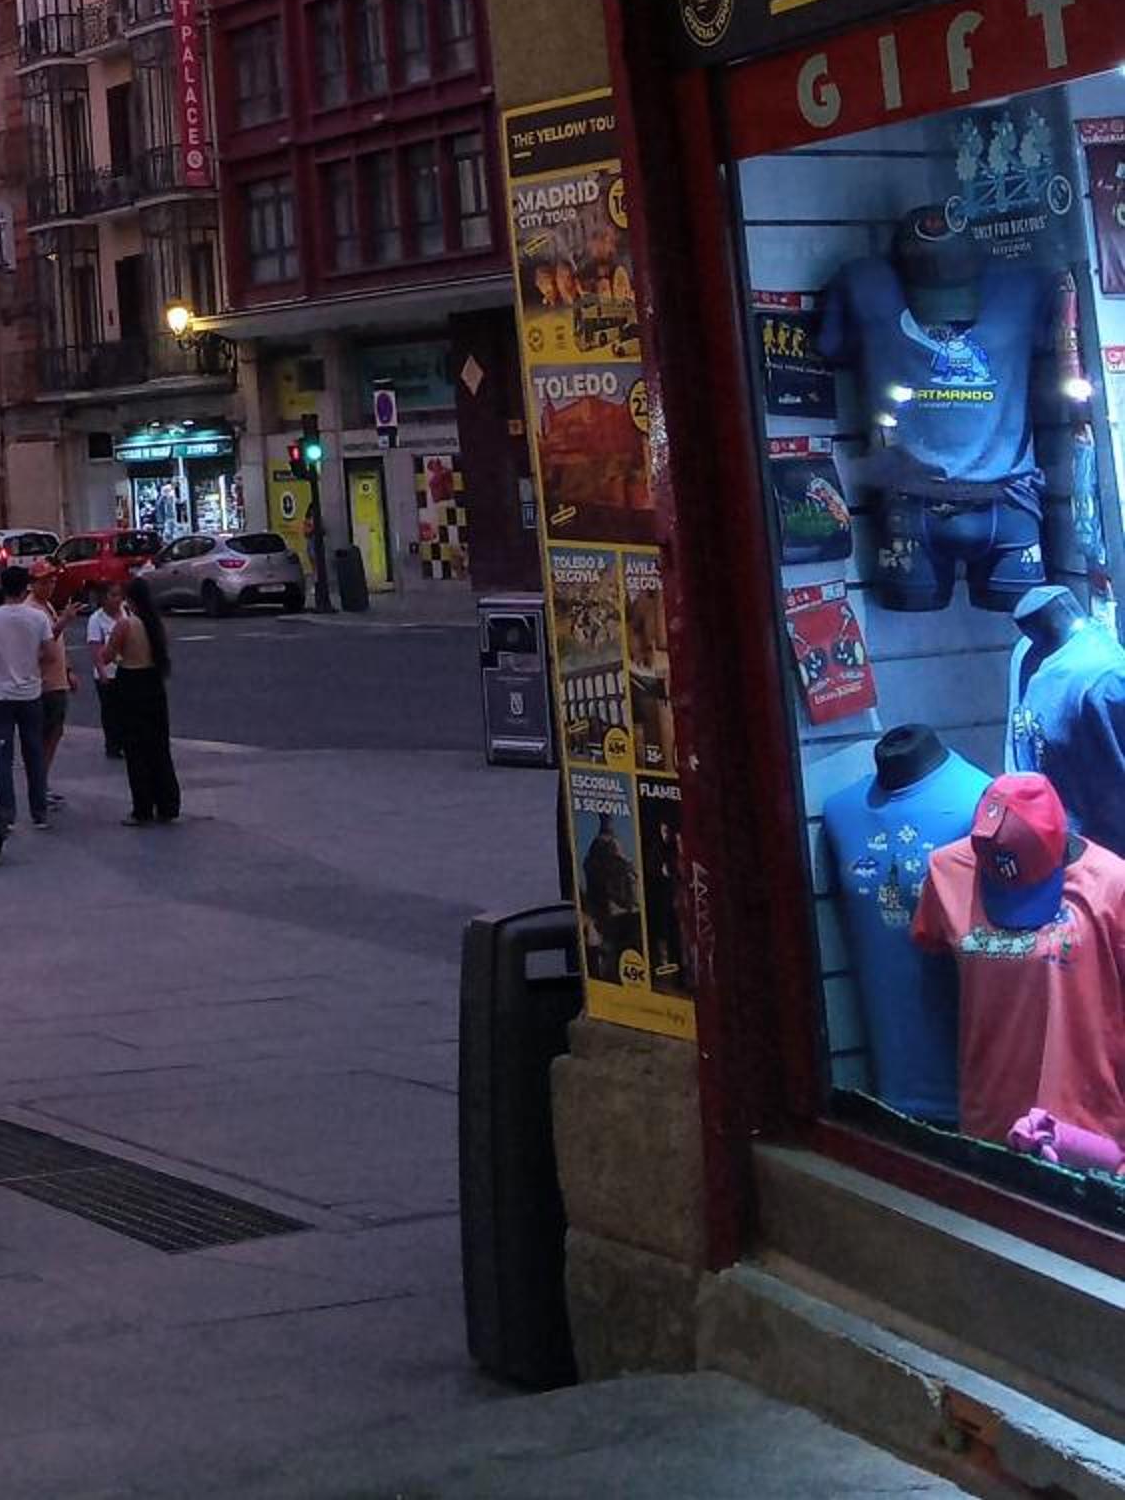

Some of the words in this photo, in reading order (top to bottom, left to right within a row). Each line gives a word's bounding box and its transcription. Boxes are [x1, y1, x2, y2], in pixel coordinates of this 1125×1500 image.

[182, 26, 200, 145] PALACE
[512, 130, 536, 149] THE
[536, 120, 586, 145] YELLOW
[516, 180, 600, 212] MADRID
[518, 213, 546, 230] CITY
[546, 208, 577, 226] TOUR
[534, 371, 618, 400] TOLEDO
[552, 554, 596, 569] TOLEDO
[554, 569, 600, 583] SEGOVIA
[571, 774, 624, 793] ESCORIAL
[583, 798, 631, 817] SEGOVIA
